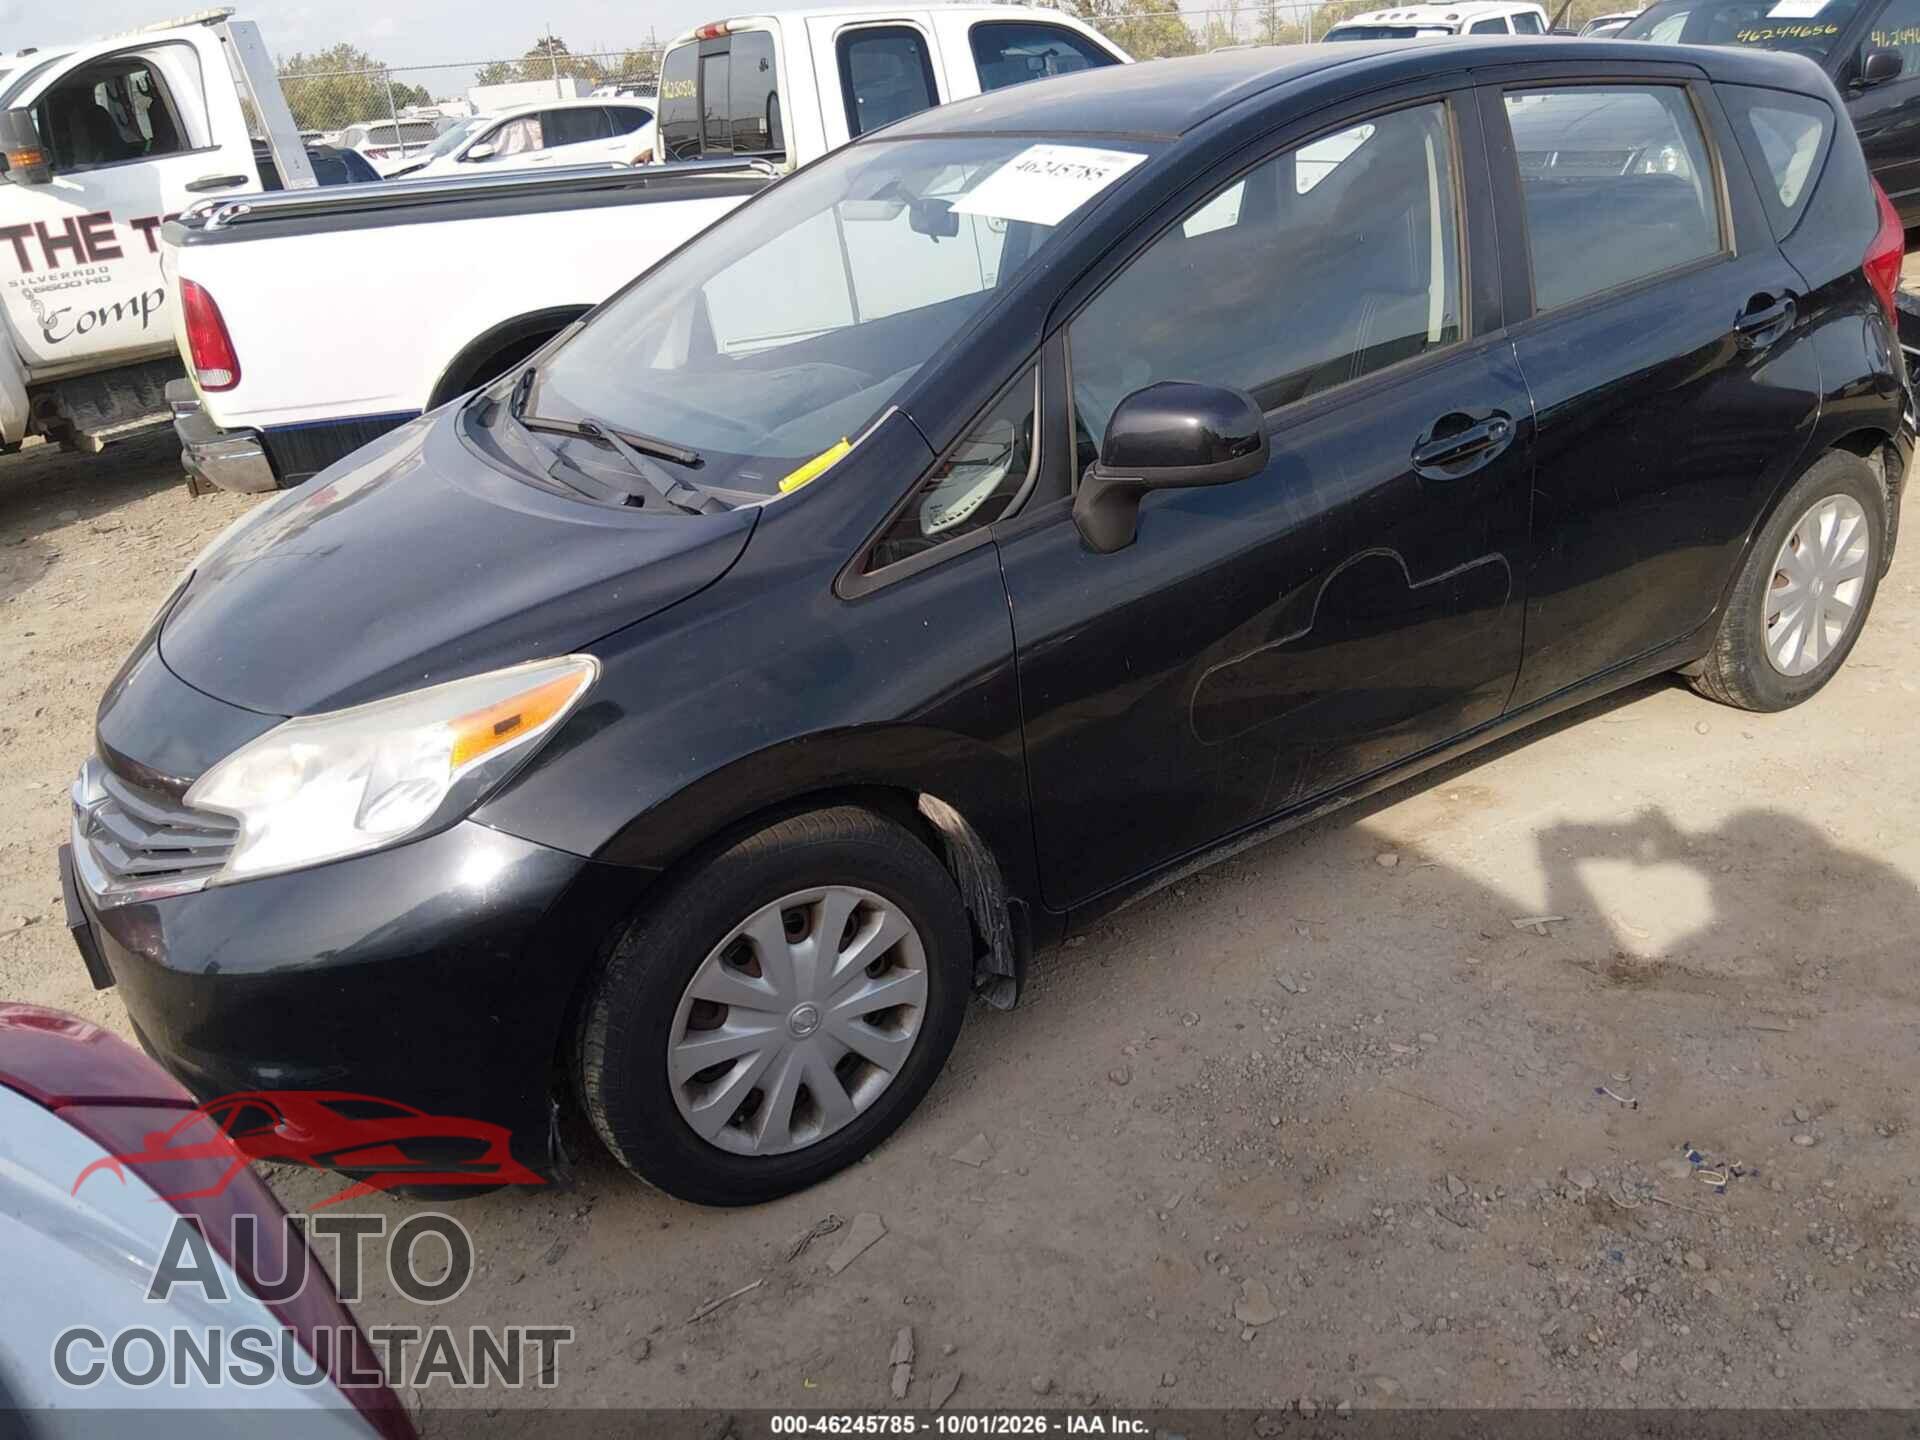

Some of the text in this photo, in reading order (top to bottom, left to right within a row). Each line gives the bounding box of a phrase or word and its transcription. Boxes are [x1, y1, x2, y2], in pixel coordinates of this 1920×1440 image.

[1736, 25, 1838, 43] 46244656
[0, 211, 124, 273] THE
[8, 266, 109, 288] SILVERADO
